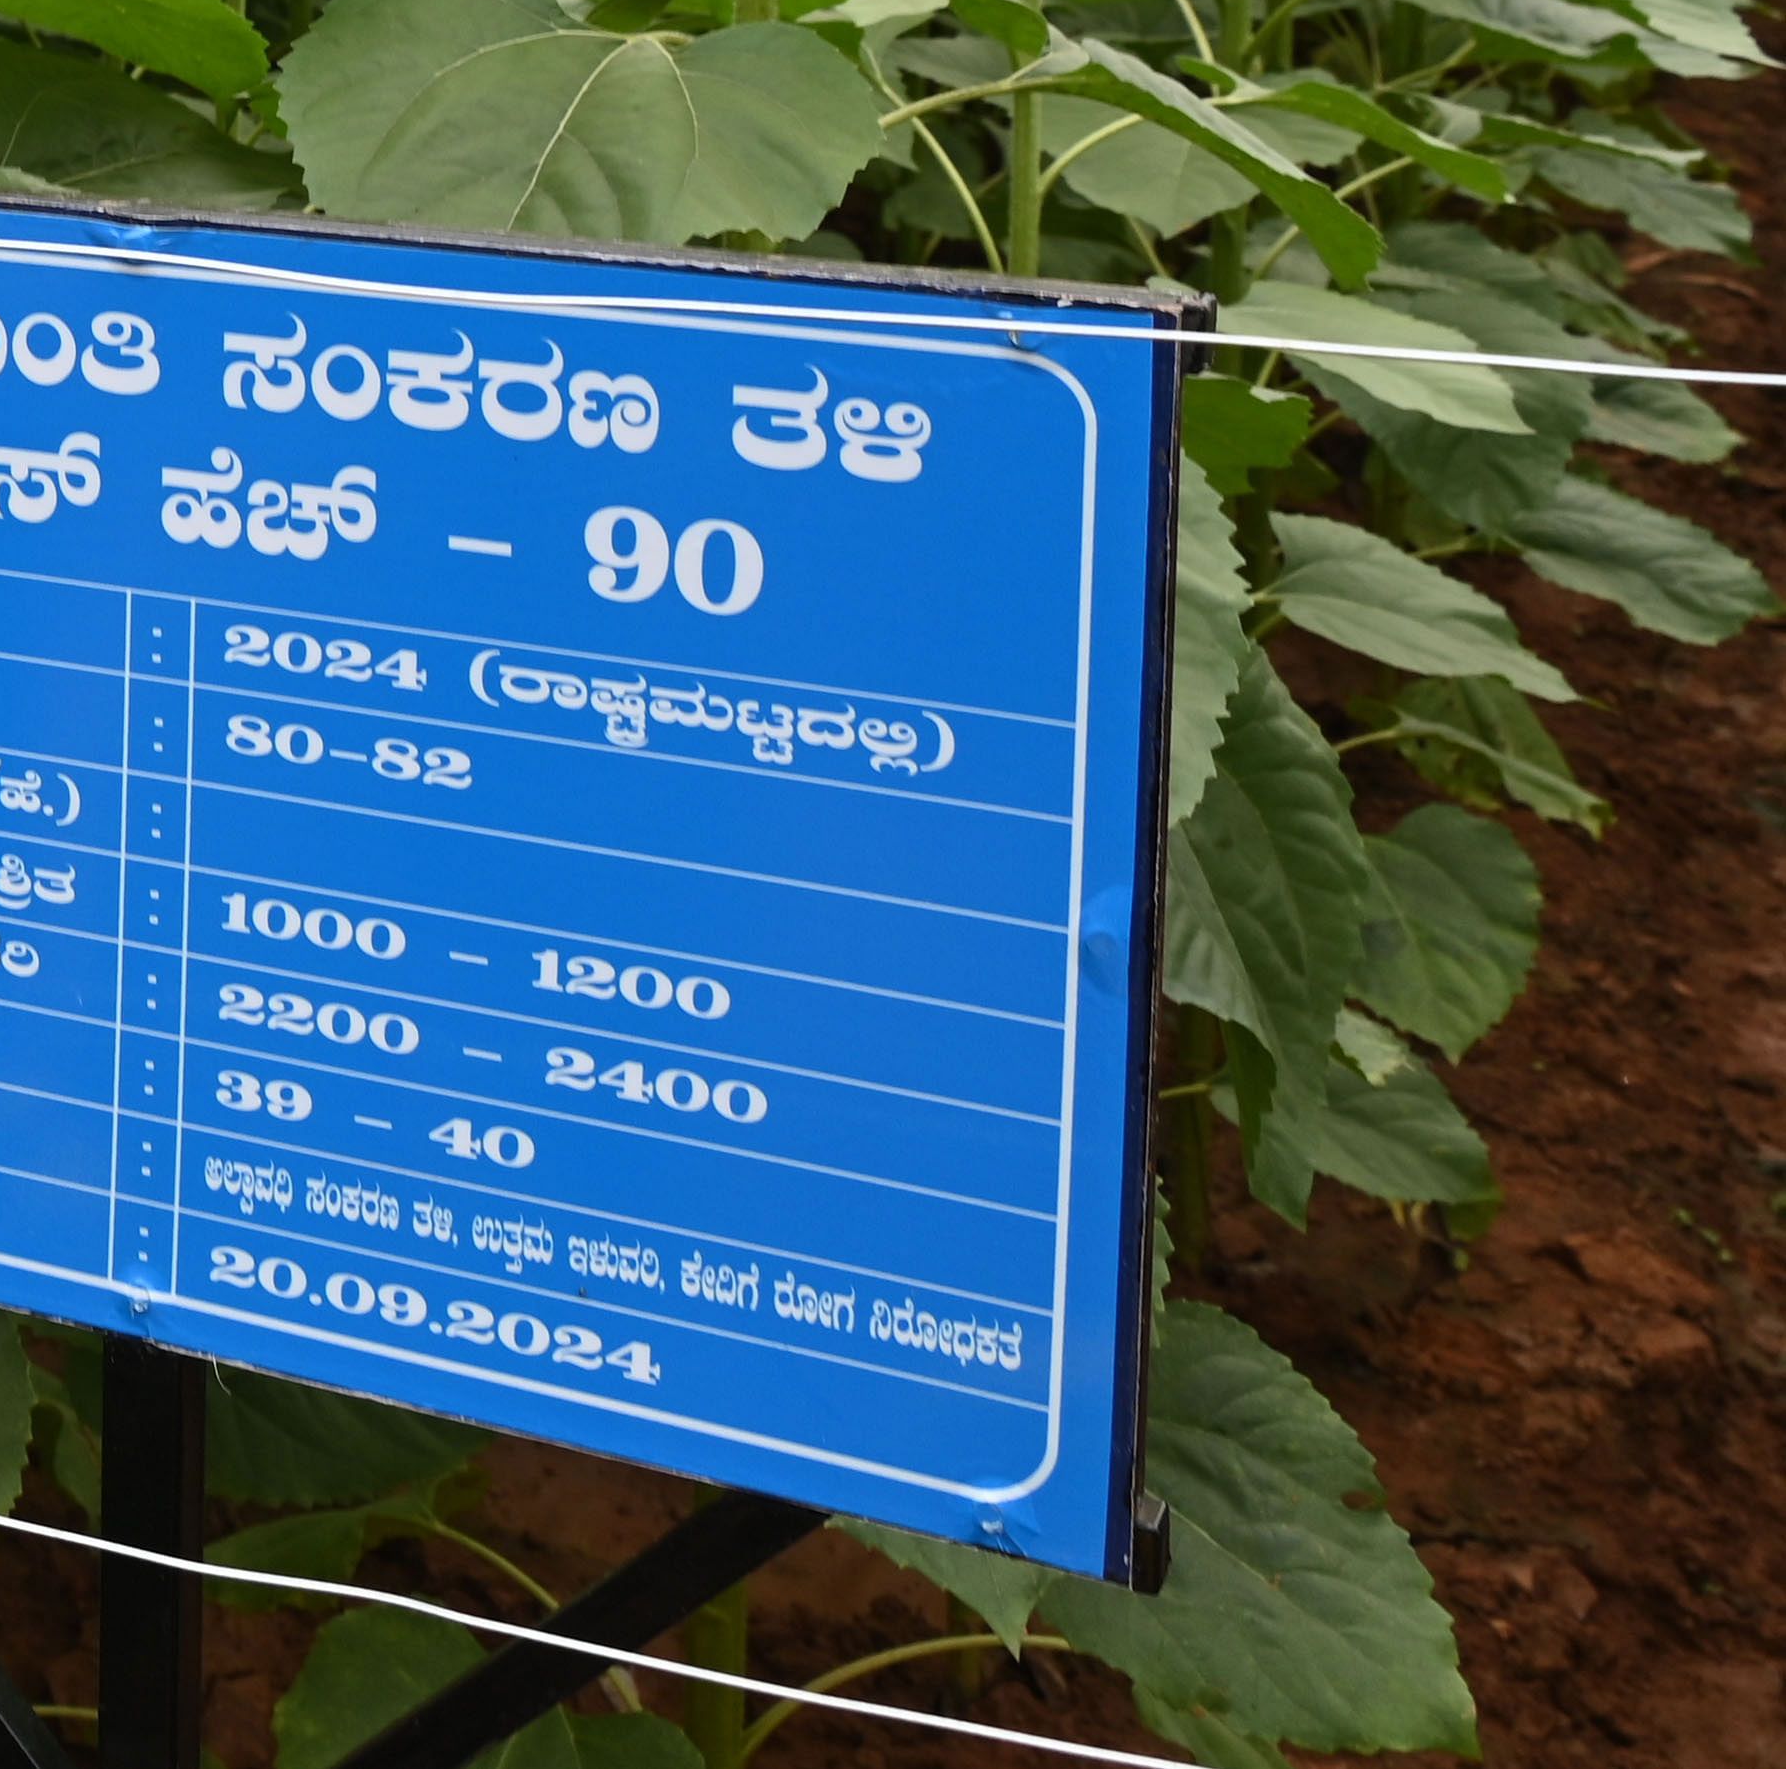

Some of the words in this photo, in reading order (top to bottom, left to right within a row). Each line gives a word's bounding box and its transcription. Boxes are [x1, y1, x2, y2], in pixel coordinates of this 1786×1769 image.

[224, 316, 659, 452] ಸಂಕರಣ
[733, 368, 931, 481] ತಳಿ
[162, 448, 376, 559] ಹೆಚ್
[585, 507, 763, 615] 90
[225, 626, 426, 690] 2024
[223, 894, 406, 958] 1000
[533, 950, 730, 1018] 1200
[217, 1071, 312, 1120] 39
[430, 1119, 534, 1167] 40
[220, 985, 419, 1053] 2200
[546, 1048, 767, 1122] 2400
[210, 1246, 661, 1385] 20.09.2024
[307, 1177, 399, 1229] ಸಂಕರಣ
[473, 1217, 552, 1273] ಉತ್ತಮ
[682, 1252, 759, 1309] ಕೇದಿಗೆ
[775, 1272, 854, 1331] ರೋಗ
[870, 1299, 1021, 1370] ನಿರೋಧಕತೆ
